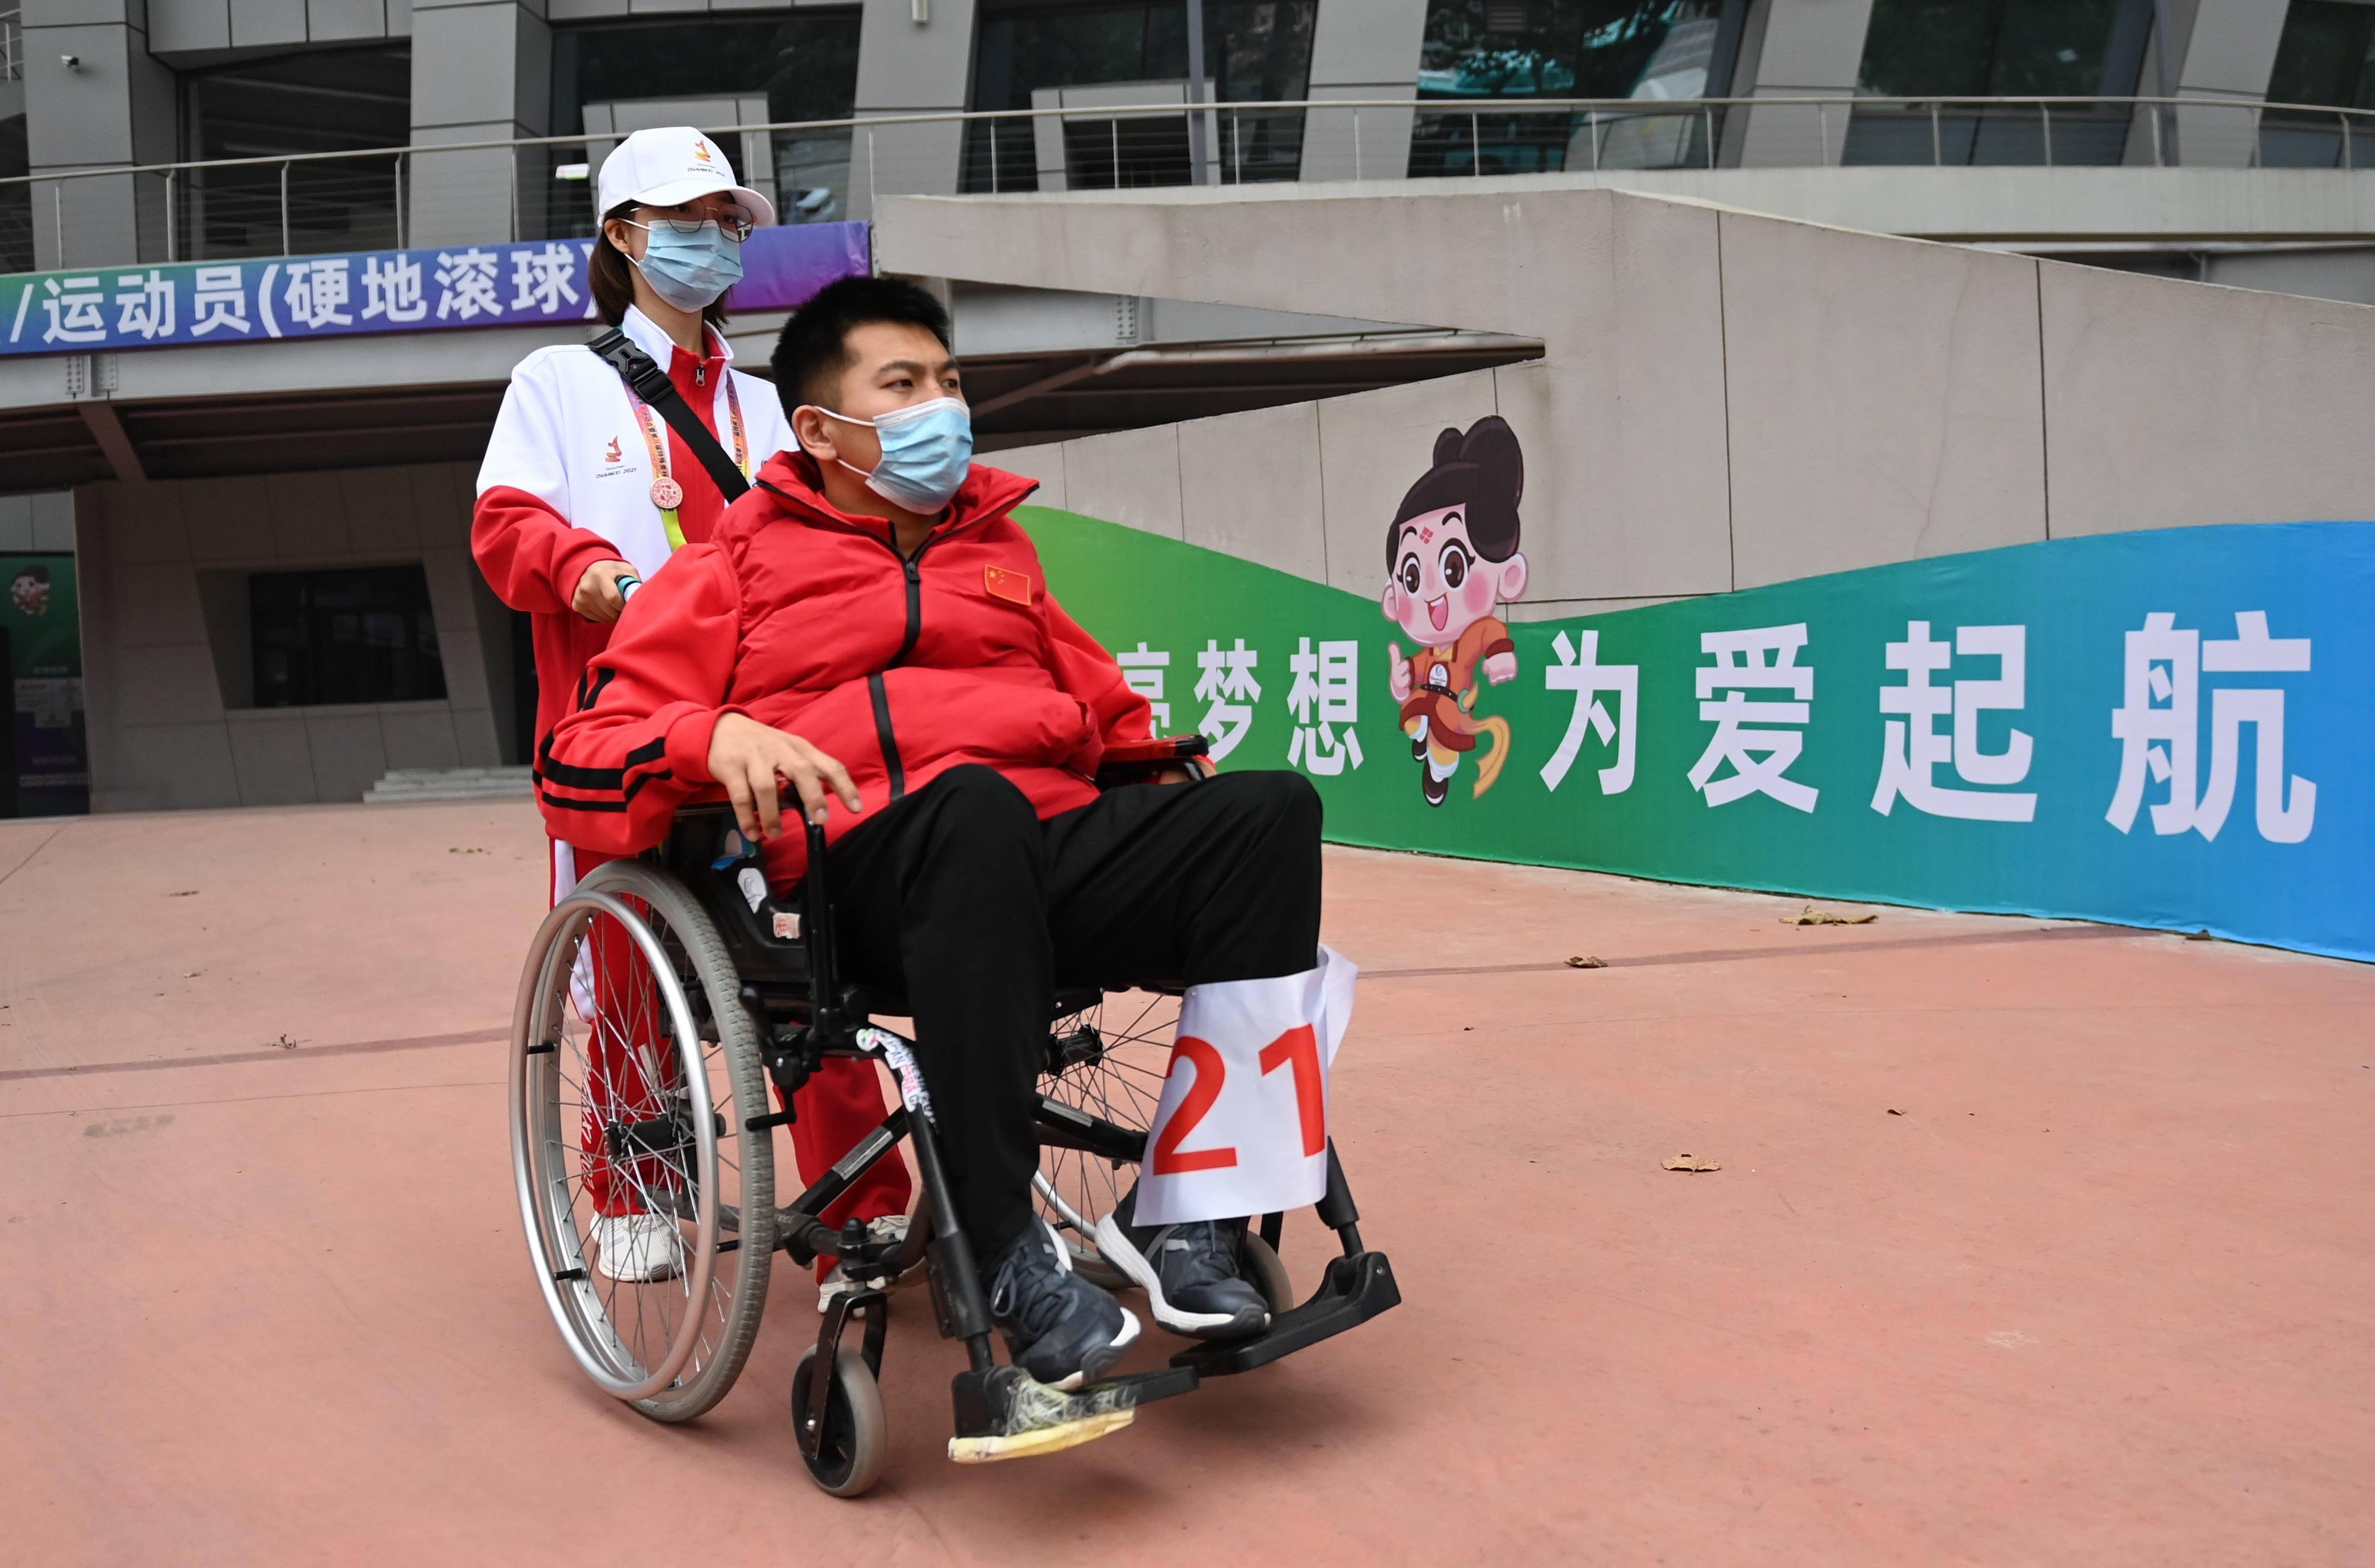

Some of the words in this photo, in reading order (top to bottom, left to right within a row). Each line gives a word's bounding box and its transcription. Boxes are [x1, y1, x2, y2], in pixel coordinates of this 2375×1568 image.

[1540, 610, 2317, 844] 为爱起航
[1153, 1023, 1325, 1176] 21
